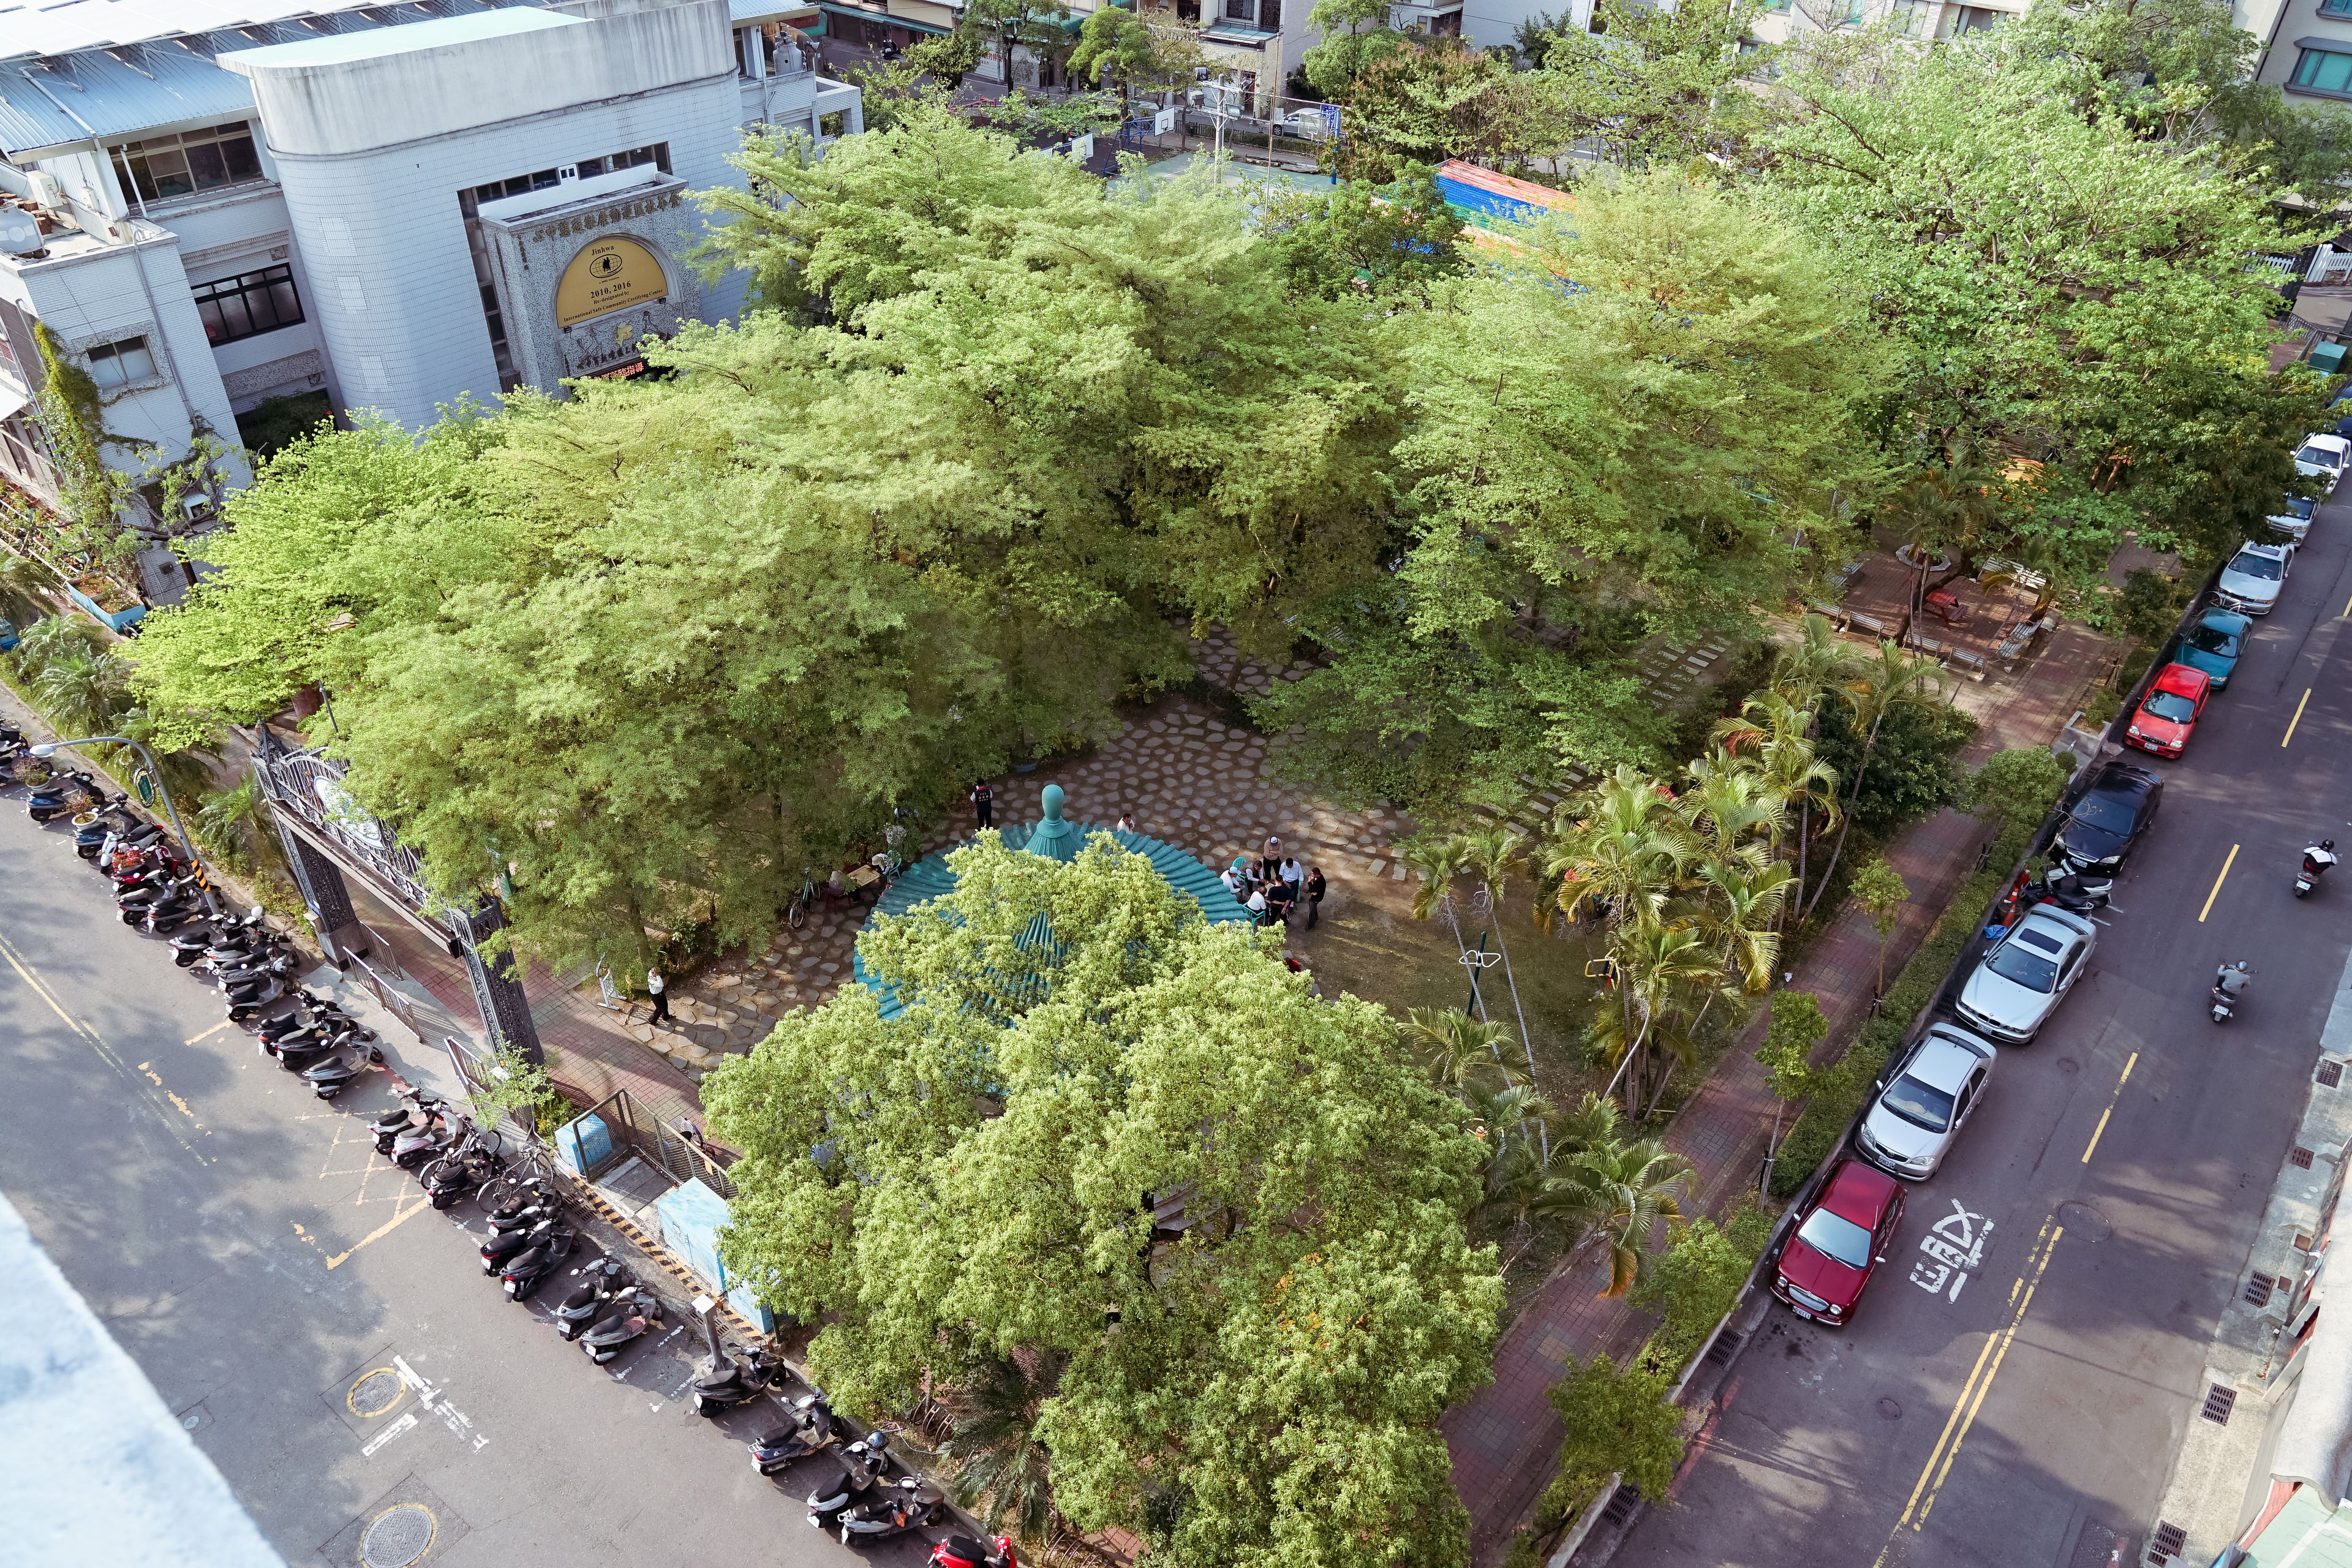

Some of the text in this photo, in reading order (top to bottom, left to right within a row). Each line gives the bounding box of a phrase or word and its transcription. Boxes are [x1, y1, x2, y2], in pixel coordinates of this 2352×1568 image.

[591, 245, 614, 256] Jinhwa
[590, 281, 631, 299] 2010, 2016
[594, 292, 624, 304] Re-designated
[564, 309, 592, 322] International
[602, 300, 627, 311] Community
[627, 293, 649, 303] Certifying
[1909, 1197, 1995, 1305] 慢
